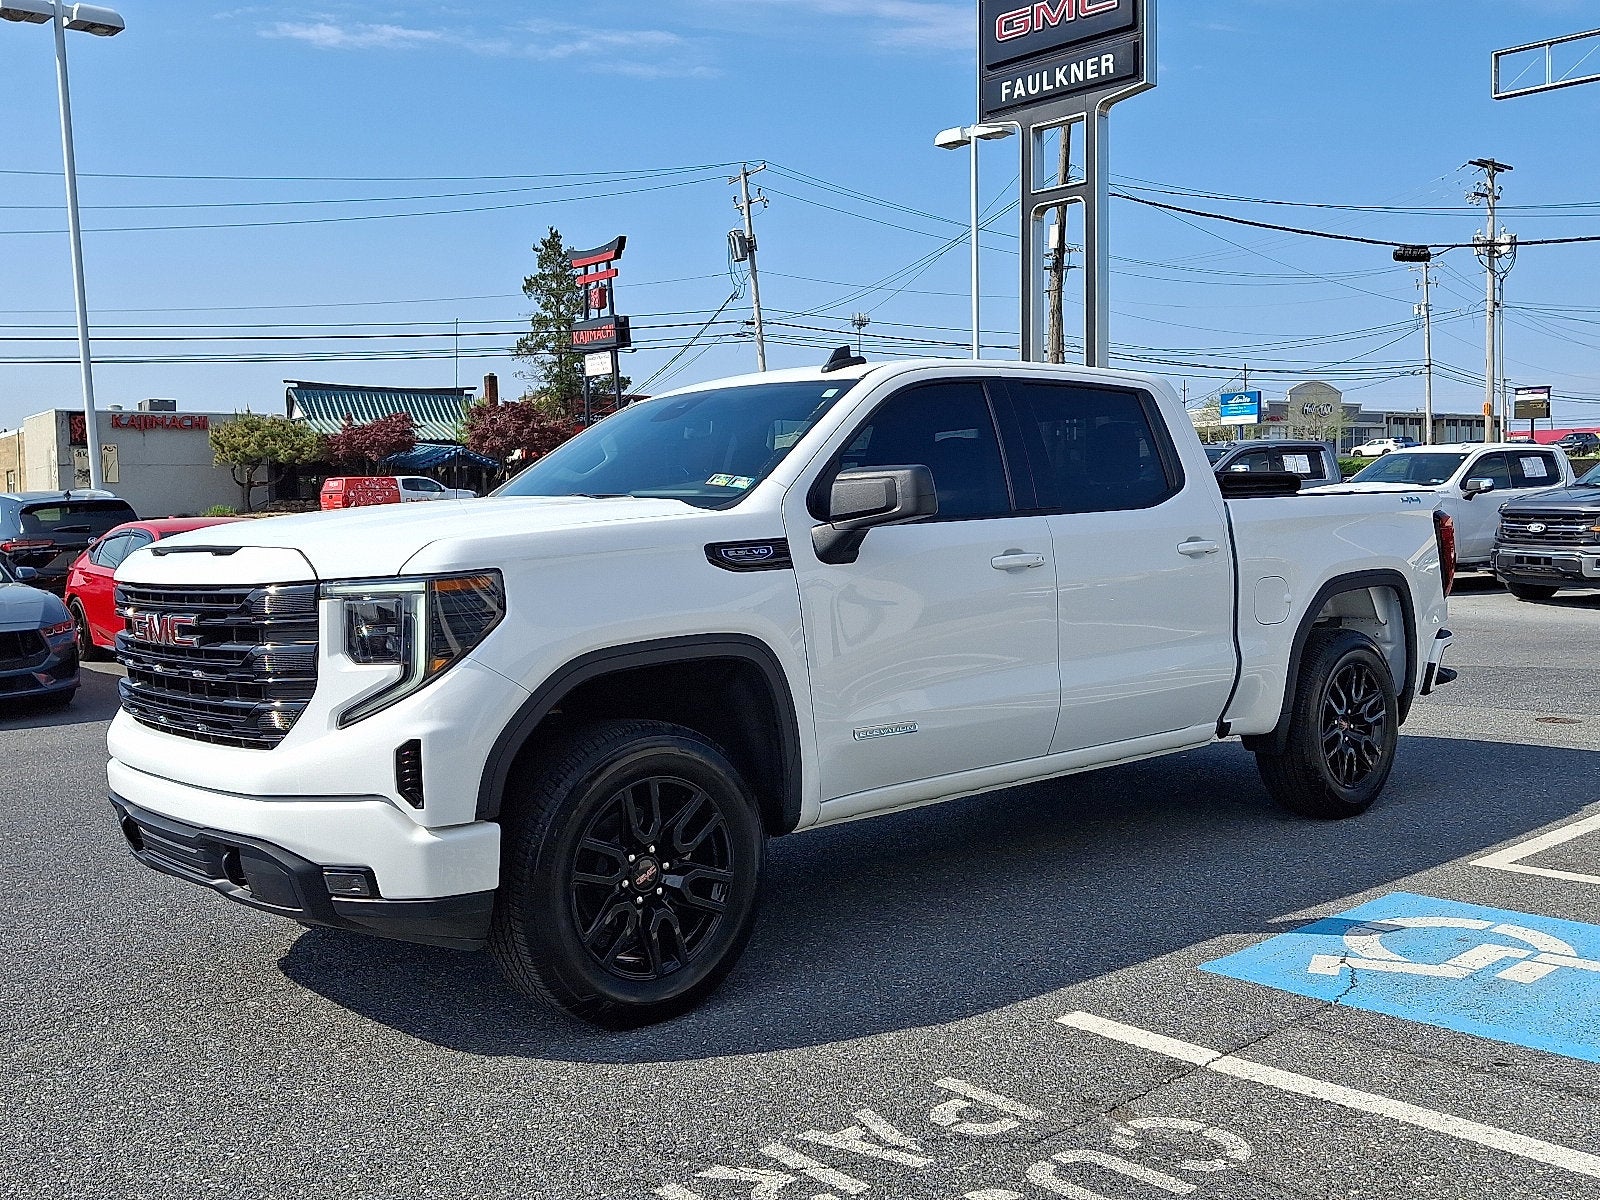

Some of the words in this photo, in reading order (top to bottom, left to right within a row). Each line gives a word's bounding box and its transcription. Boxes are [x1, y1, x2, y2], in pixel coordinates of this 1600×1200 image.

[1001, 53, 1115, 102] FAULKNER
[572, 323, 615, 345] KAJIMACHI
[111, 414, 209, 432] KAJIMACHI
[132, 613, 199, 647] GMC
[652, 1076, 1043, 1200] PAR
